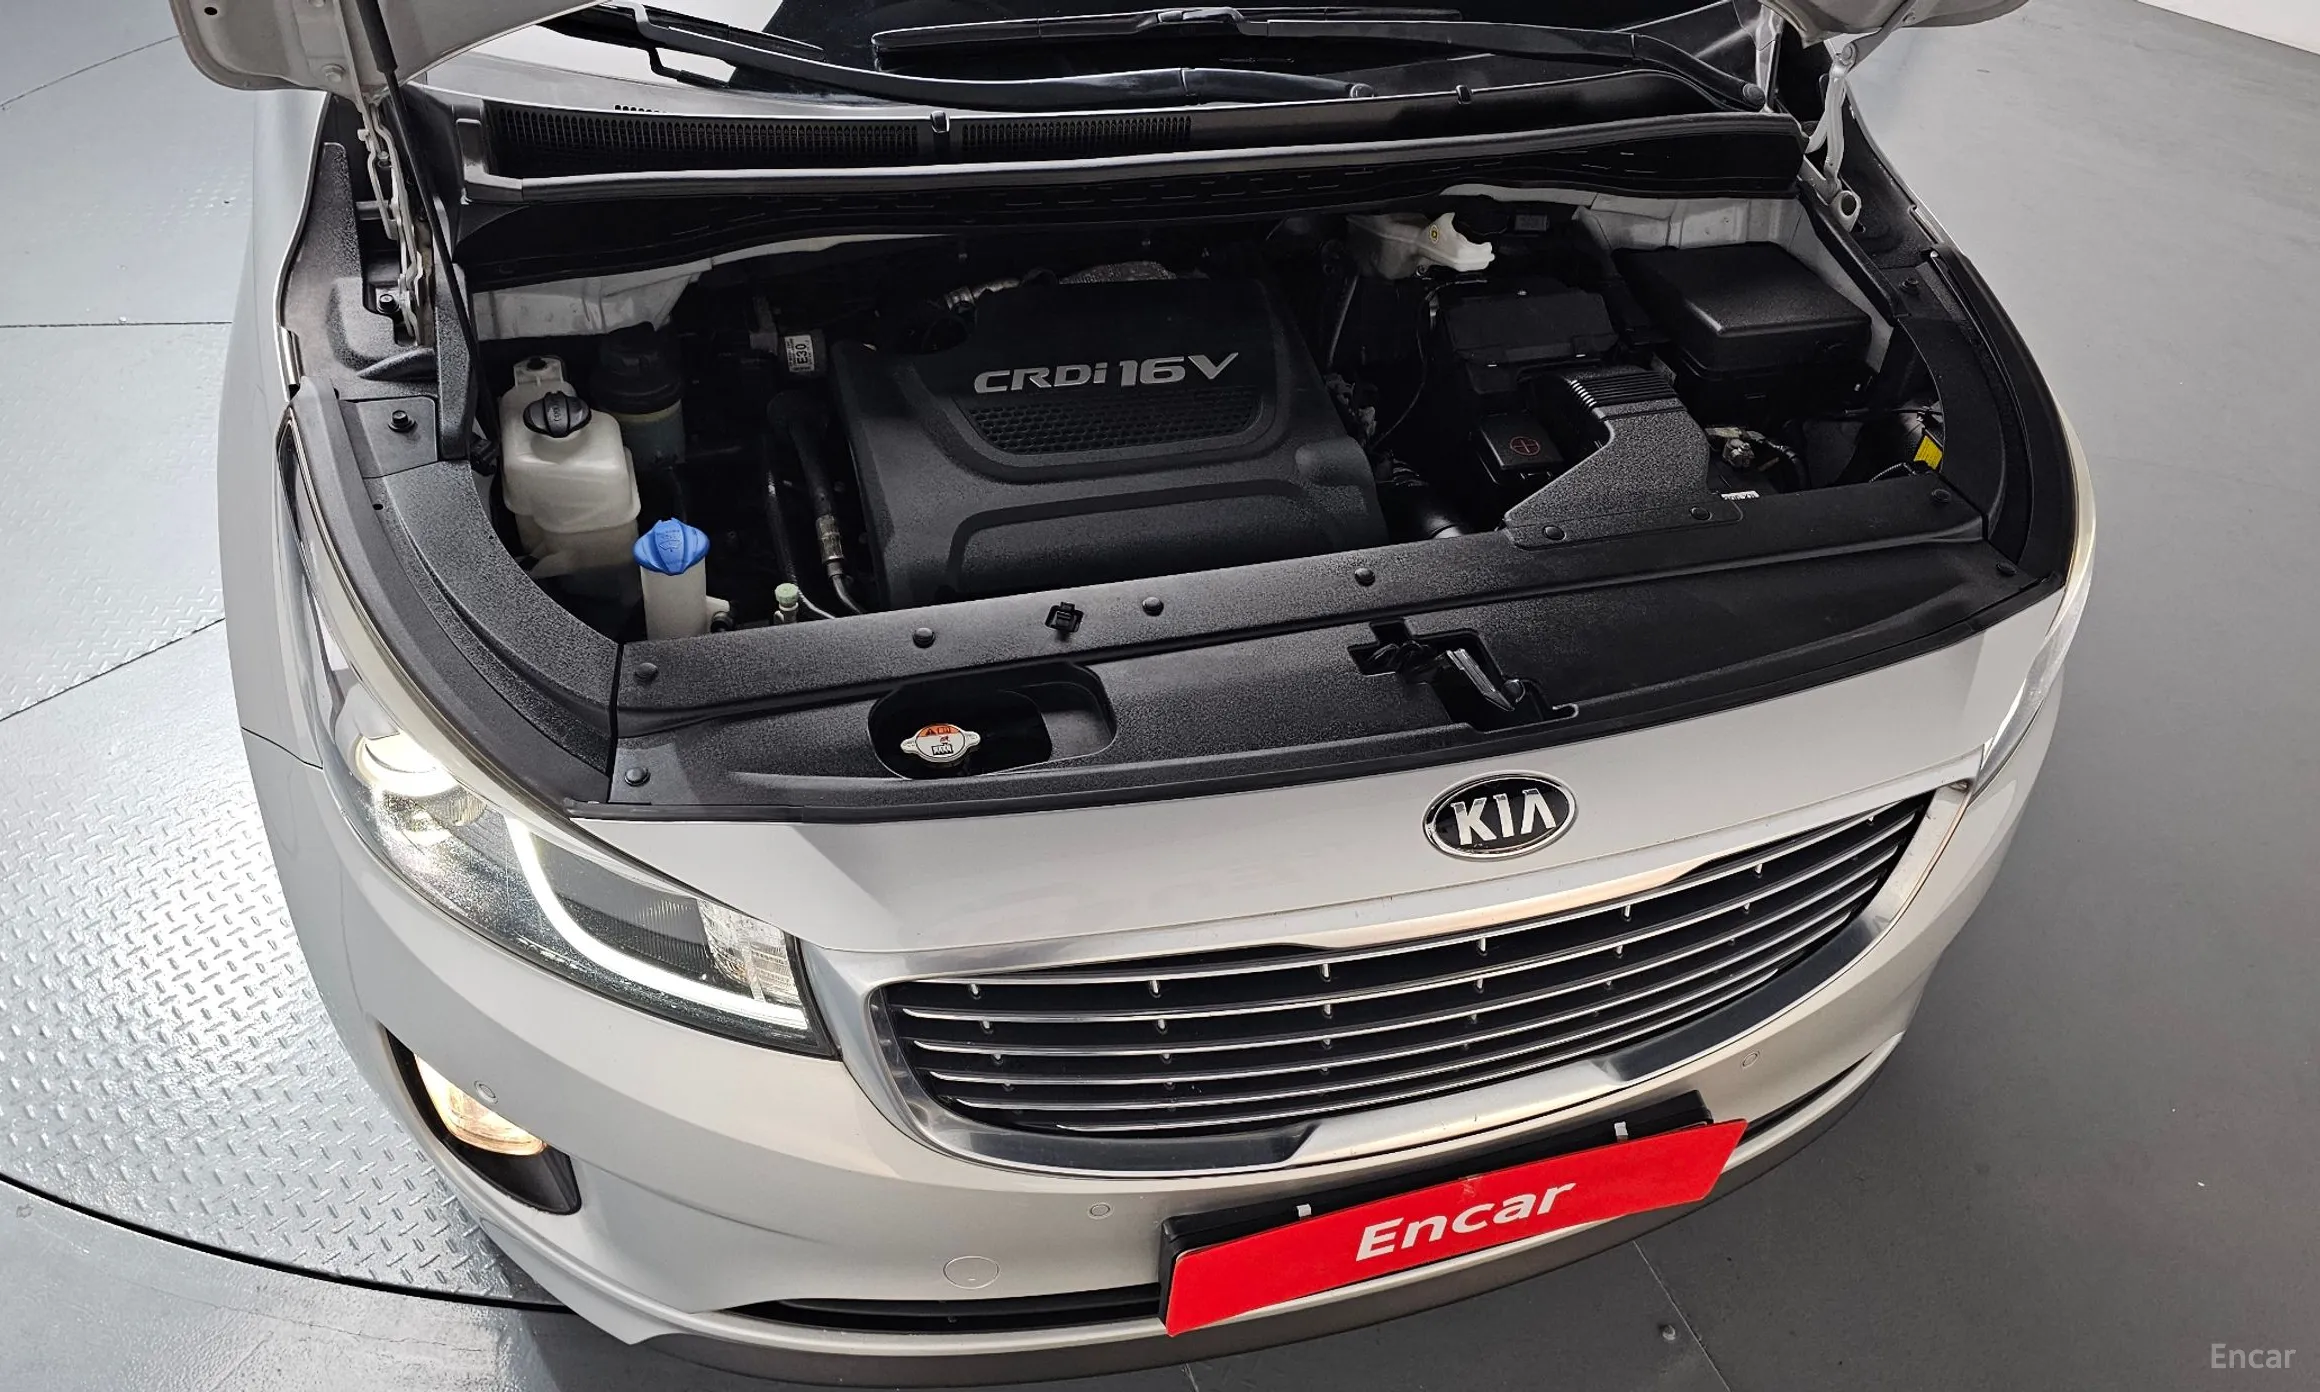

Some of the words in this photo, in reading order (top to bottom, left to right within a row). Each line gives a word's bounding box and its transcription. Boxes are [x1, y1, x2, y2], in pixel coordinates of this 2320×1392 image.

[795, 343, 808, 364] E30
[974, 361, 1107, 394] CRDi
[1119, 352, 1239, 387] 16V
[1450, 788, 1557, 846] KIA
[1355, 1182, 1577, 1261] Encar
